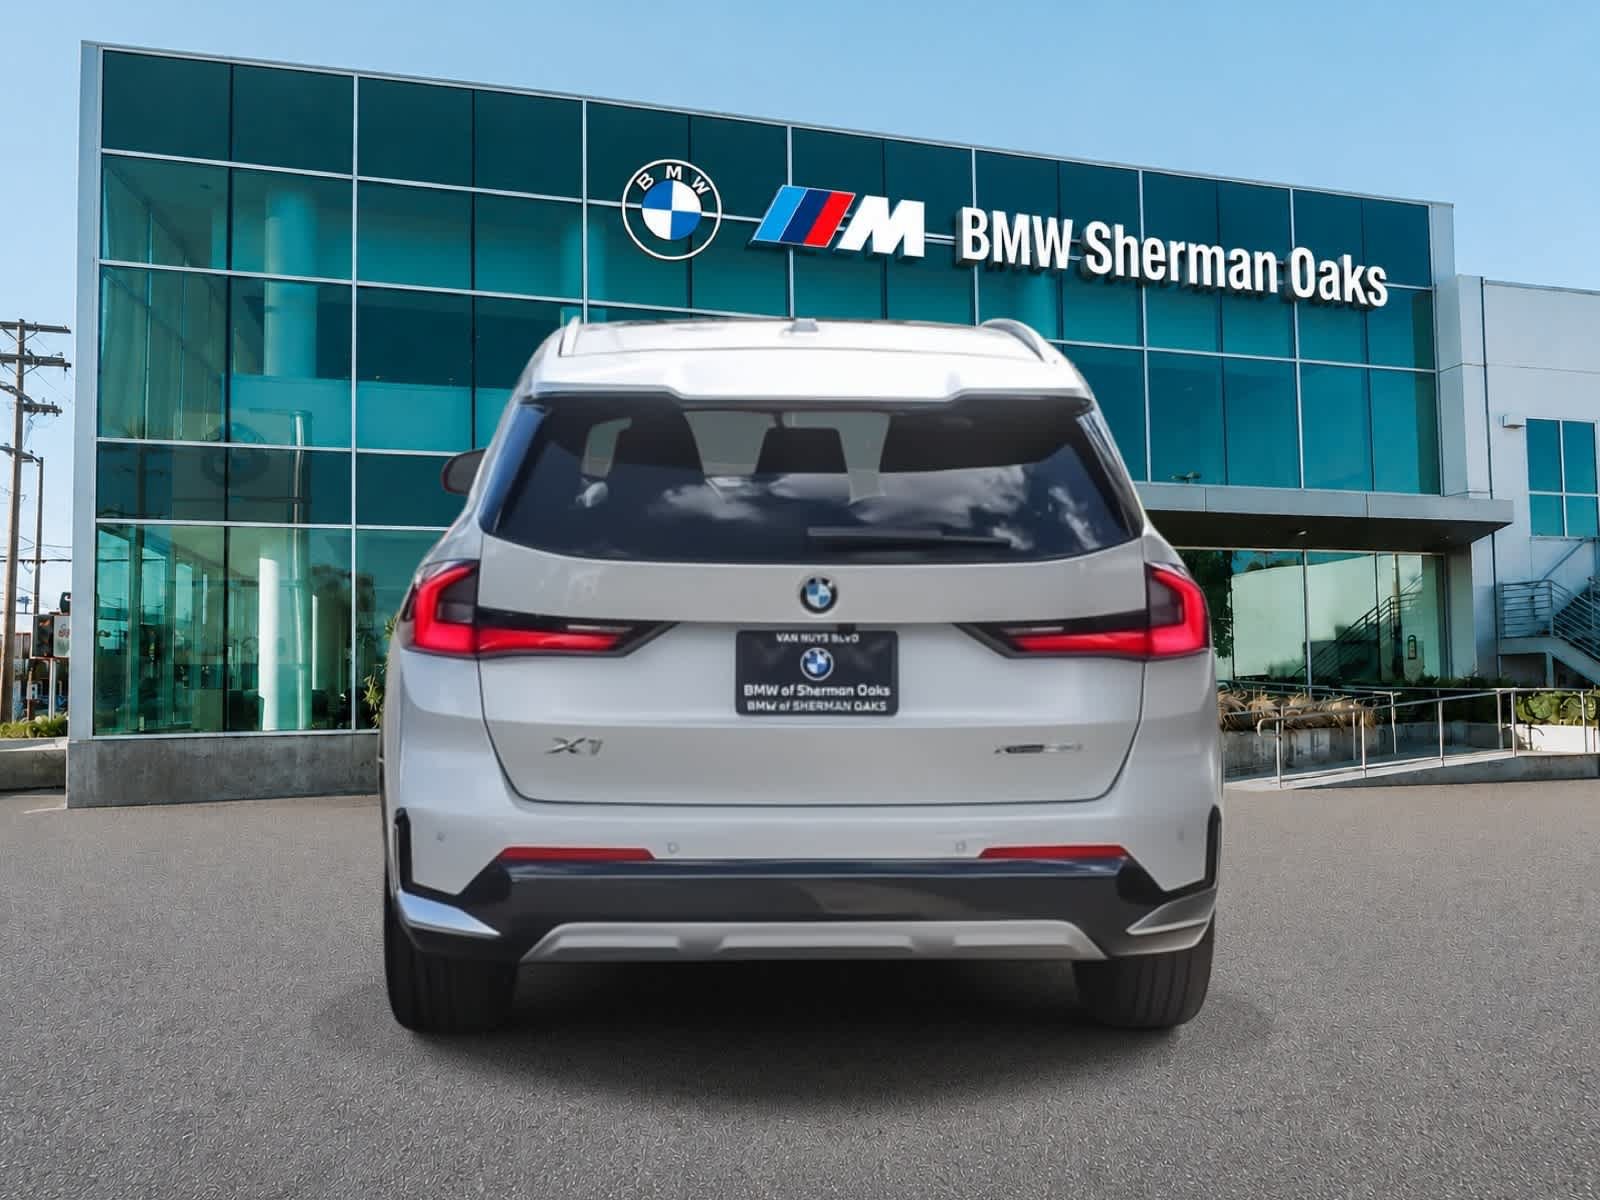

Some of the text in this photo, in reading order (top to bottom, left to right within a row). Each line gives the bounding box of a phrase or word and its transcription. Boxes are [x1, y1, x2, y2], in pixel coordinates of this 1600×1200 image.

[636, 165, 711, 195] BMW
[835, 195, 925, 258] M
[960, 206, 1388, 308] BMW Sherman Oaks
[776, 633, 798, 643] VAN
[743, 684, 891, 697] BMW of Sherman Oaks
[747, 701, 887, 712] BMW of SHERMAN OAKS
[547, 738, 603, 755] X1
